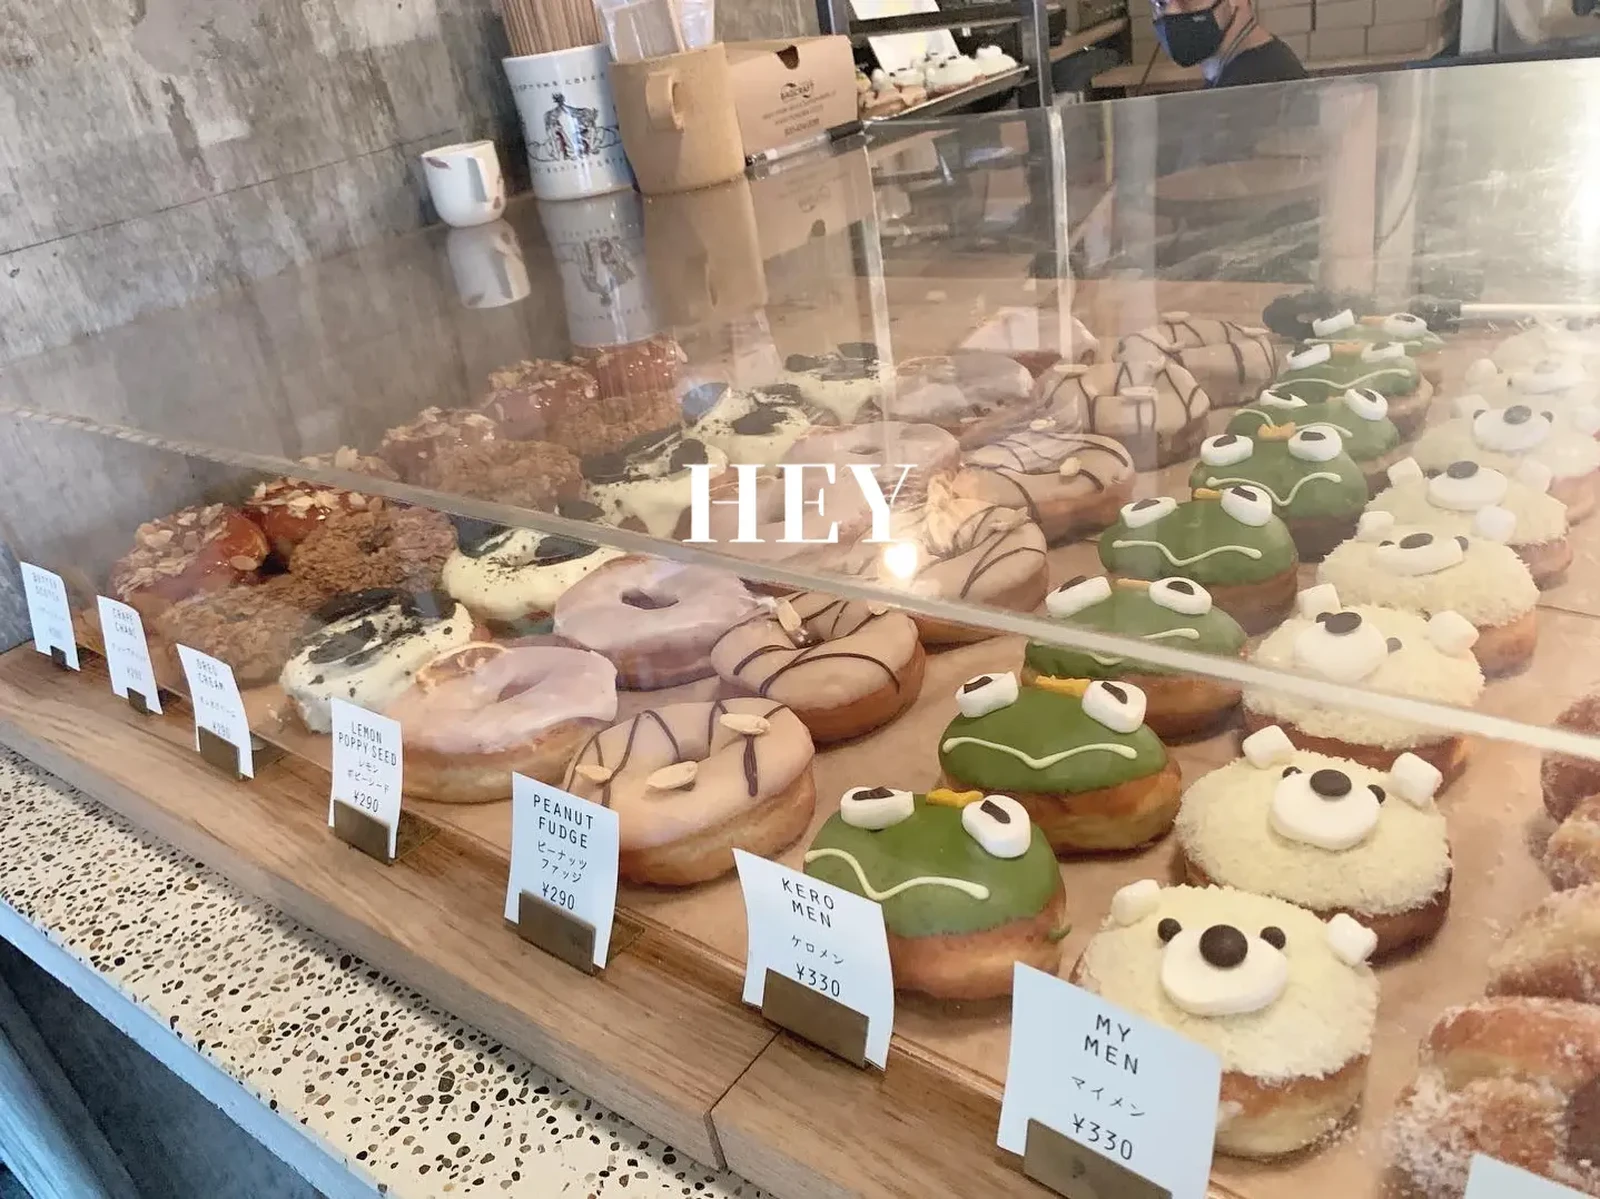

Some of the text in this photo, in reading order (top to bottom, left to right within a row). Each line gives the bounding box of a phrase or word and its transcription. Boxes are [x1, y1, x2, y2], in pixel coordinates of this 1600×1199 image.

[351, 721, 382, 745] LEMON
[338, 731, 397, 767] POPPY SEED
[358, 756, 379, 774] レモン
[353, 789, 379, 813] ¥290
[533, 794, 594, 830] PEANUT
[538, 816, 588, 849] FUDGE
[537, 840, 588, 870] ピーナッツ
[541, 858, 582, 883] ファッジ
[542, 881, 575, 911] ¥290
[781, 877, 834, 910] KERO
[791, 900, 832, 928] MEN
[791, 935, 845, 965] ケロメン
[795, 962, 841, 998] ¥330
[1095, 1013, 1132, 1043] MY
[1083, 1034, 1139, 1076] MEN
[1070, 1075, 1146, 1118] マイメン
[1072, 1112, 1134, 1161] ¥330
